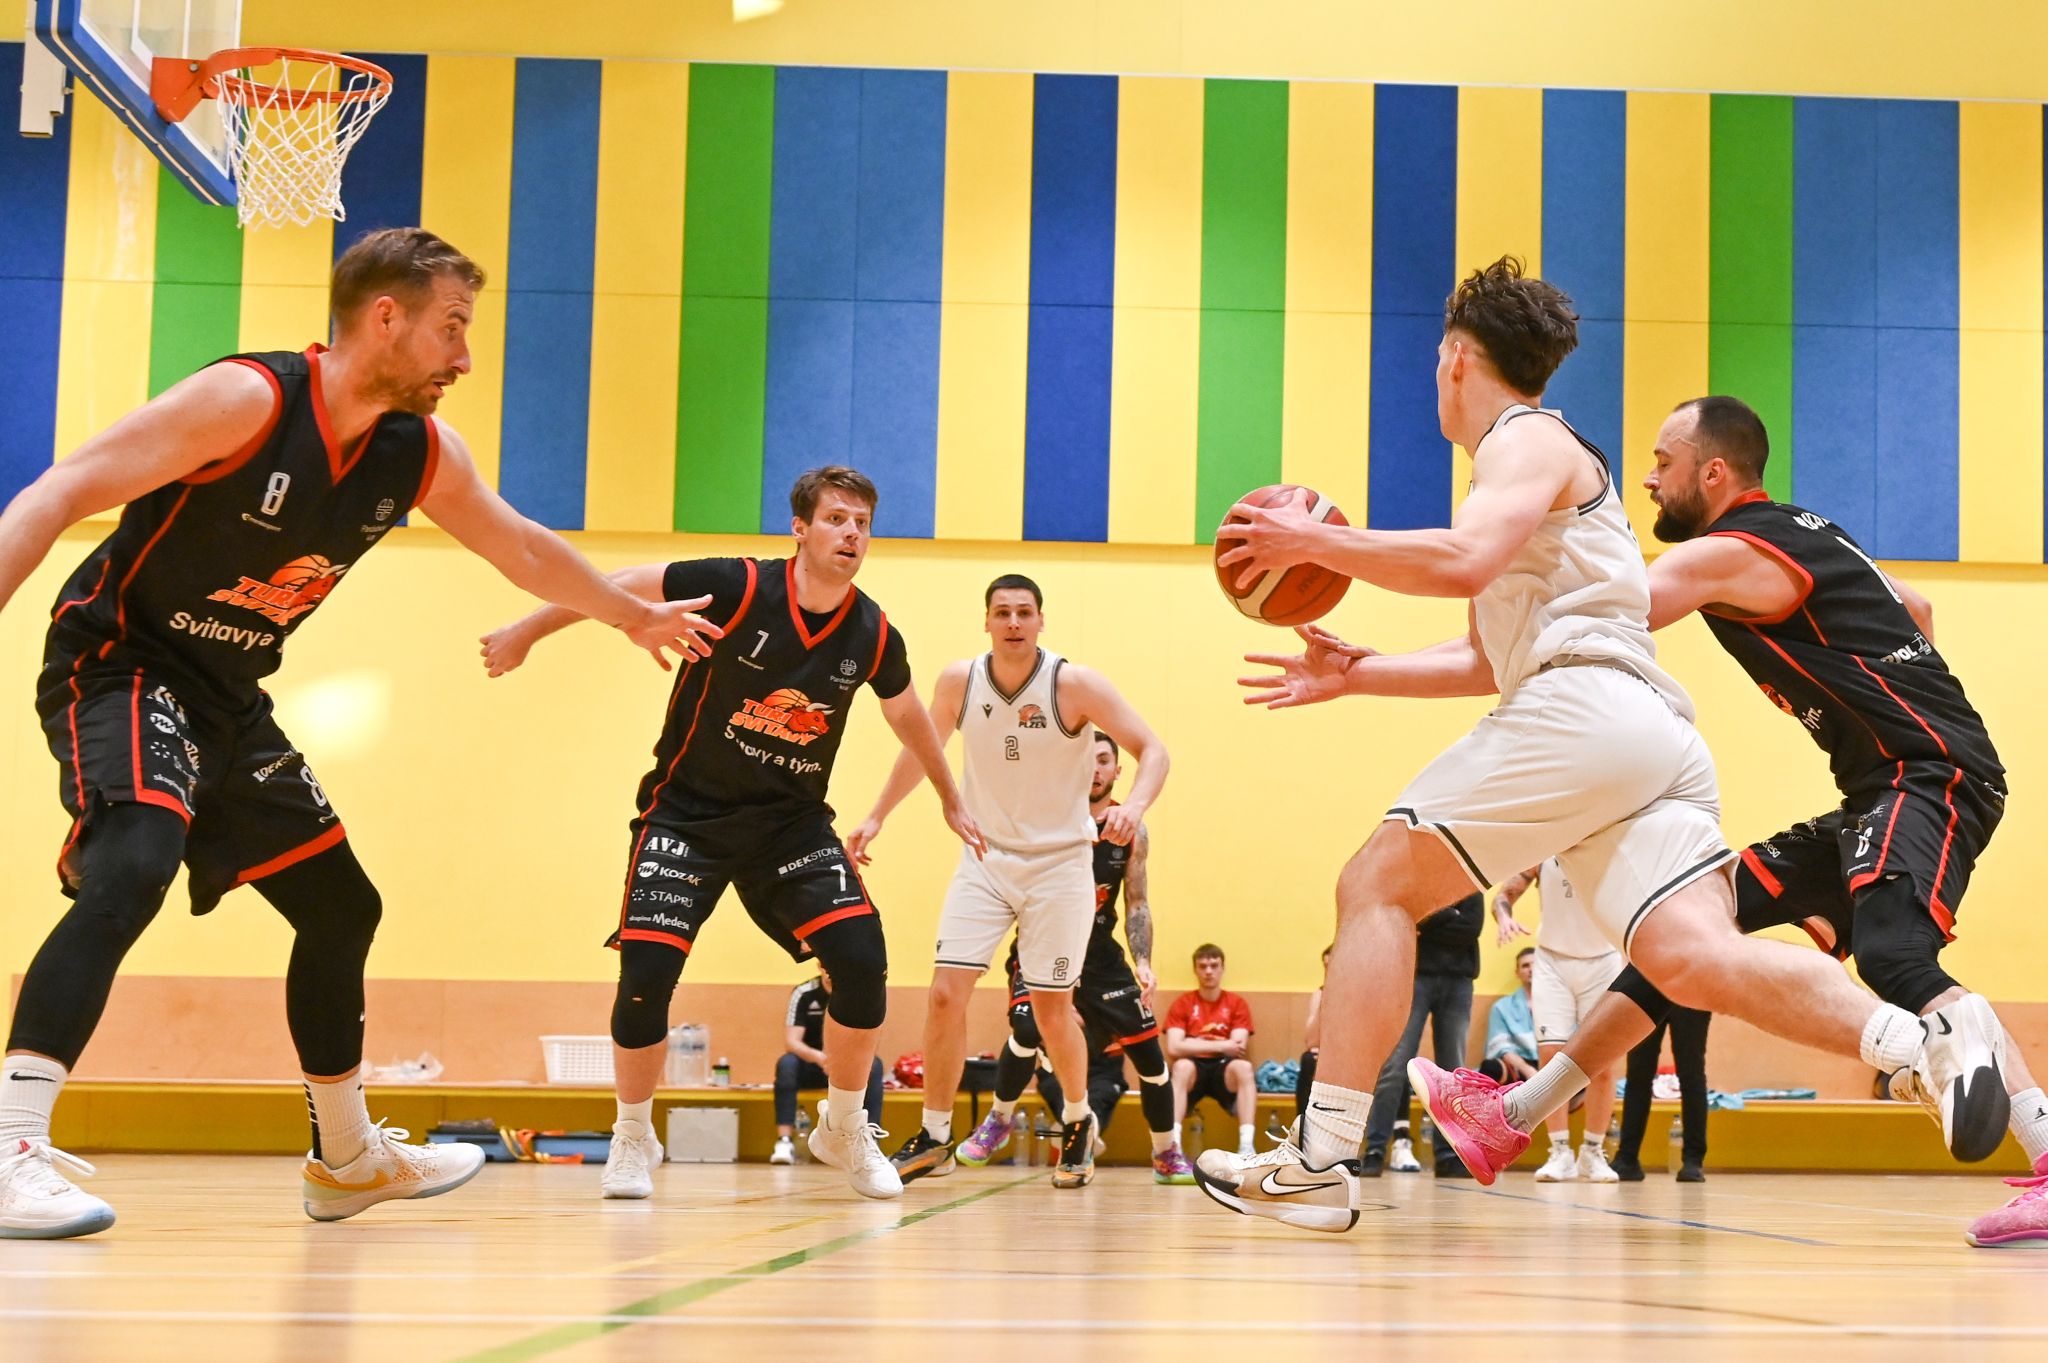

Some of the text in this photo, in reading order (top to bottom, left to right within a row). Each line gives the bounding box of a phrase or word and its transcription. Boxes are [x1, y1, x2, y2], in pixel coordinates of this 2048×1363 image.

[261, 472, 291, 516] 8
[750, 629, 770, 659] 7
[773, 755, 786, 767] a
[1004, 735, 1020, 761] 2
[300, 765, 328, 808] 8
[787, 846, 842, 872] DEKSTONE
[659, 866, 702, 887] KOZAK
[1053, 956, 1069, 981] 2
